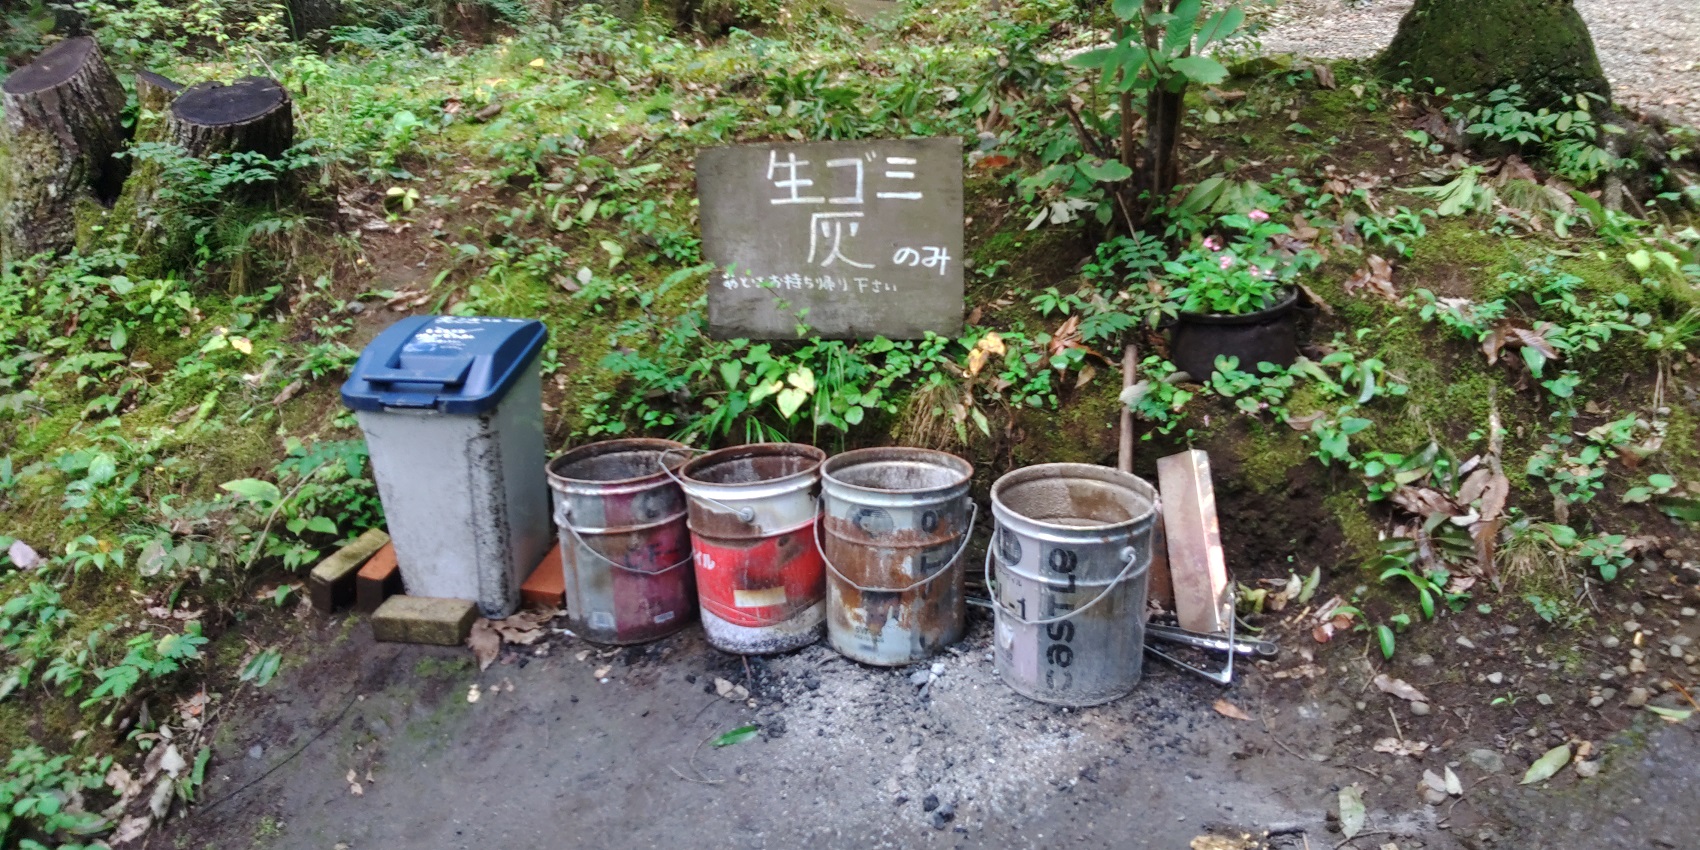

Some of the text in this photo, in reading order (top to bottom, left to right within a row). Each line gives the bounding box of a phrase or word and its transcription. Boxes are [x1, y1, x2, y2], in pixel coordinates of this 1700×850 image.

[766, 149, 923, 205] 生ゴミ
[807, 211, 951, 276] 灰 のみ
